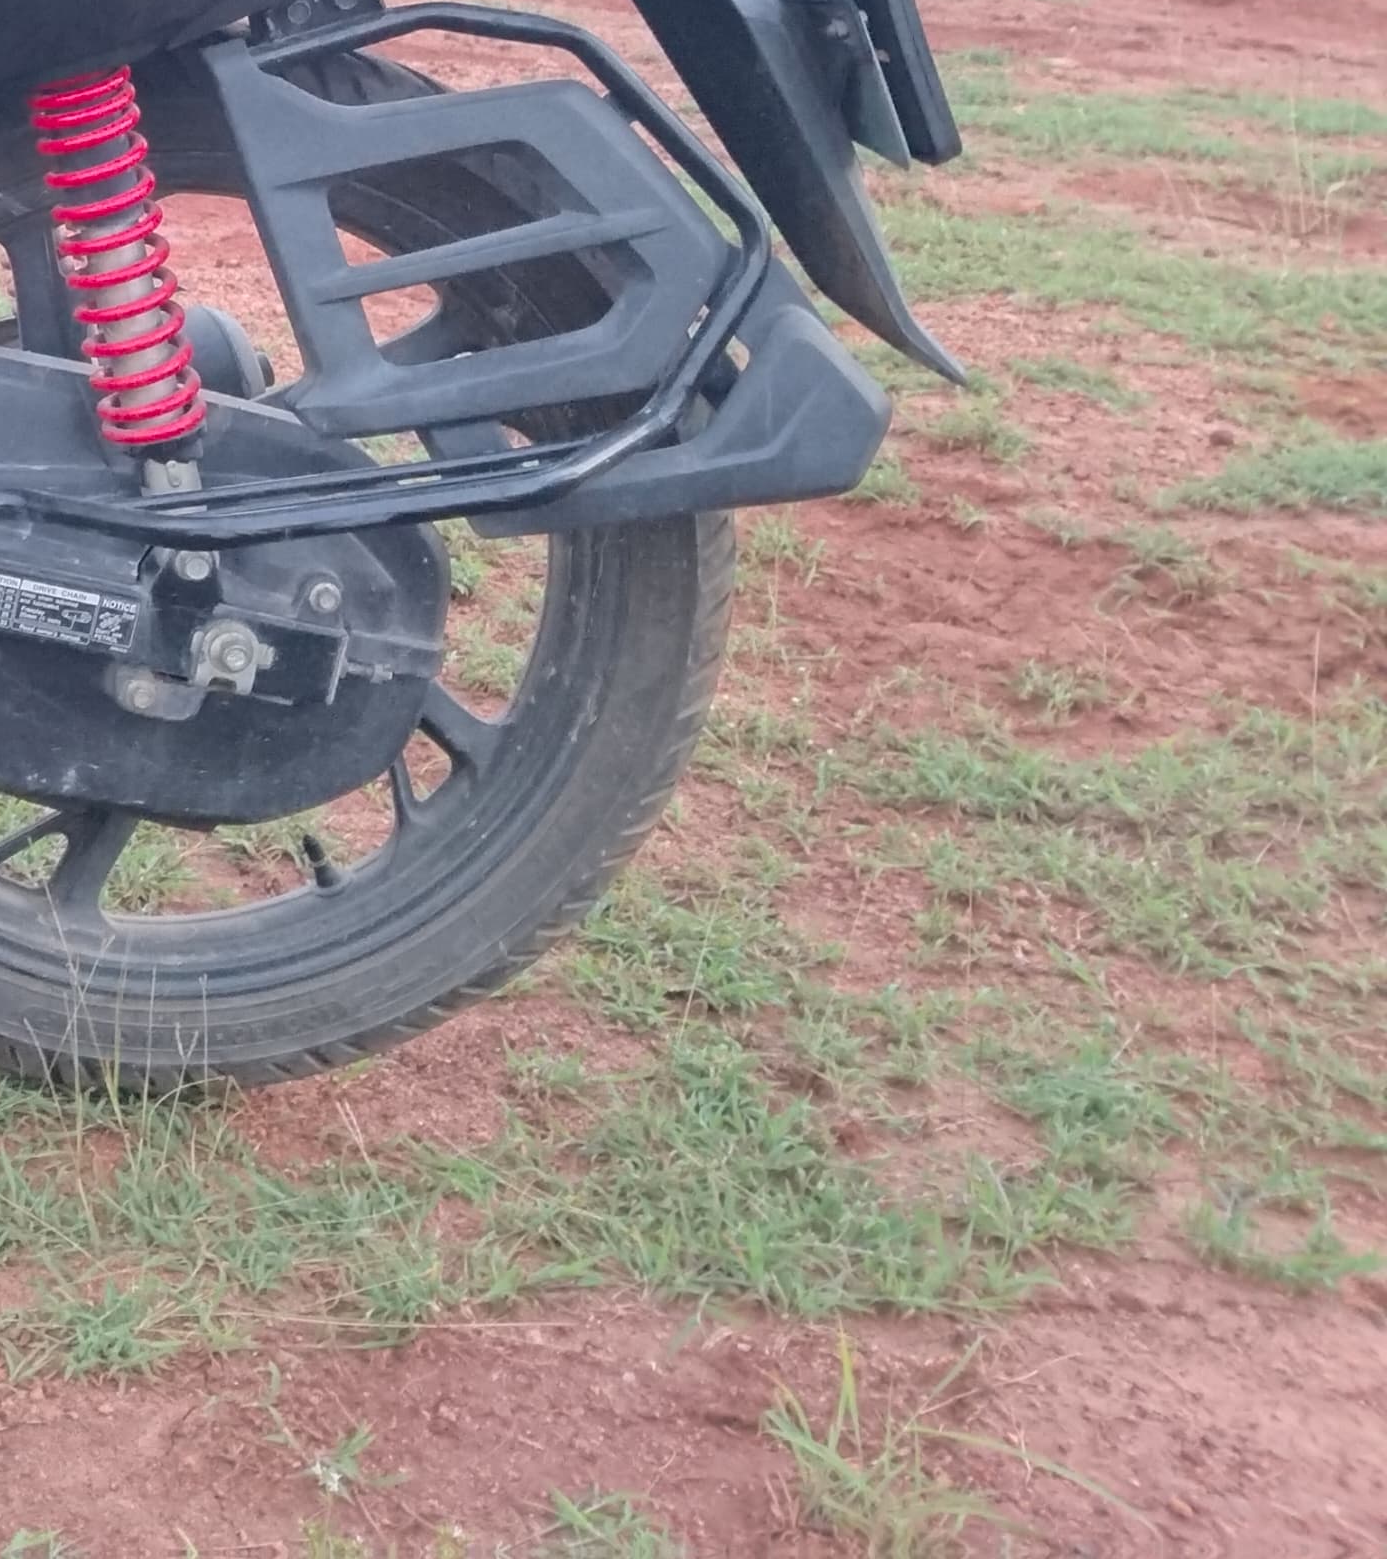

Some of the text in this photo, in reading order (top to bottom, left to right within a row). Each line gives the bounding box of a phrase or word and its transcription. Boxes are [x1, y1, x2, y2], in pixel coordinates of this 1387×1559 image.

[33, 583, 56, 595] DRIVE
[61, 589, 88, 601] CHAIN
[102, 599, 137, 614] NOTICE
